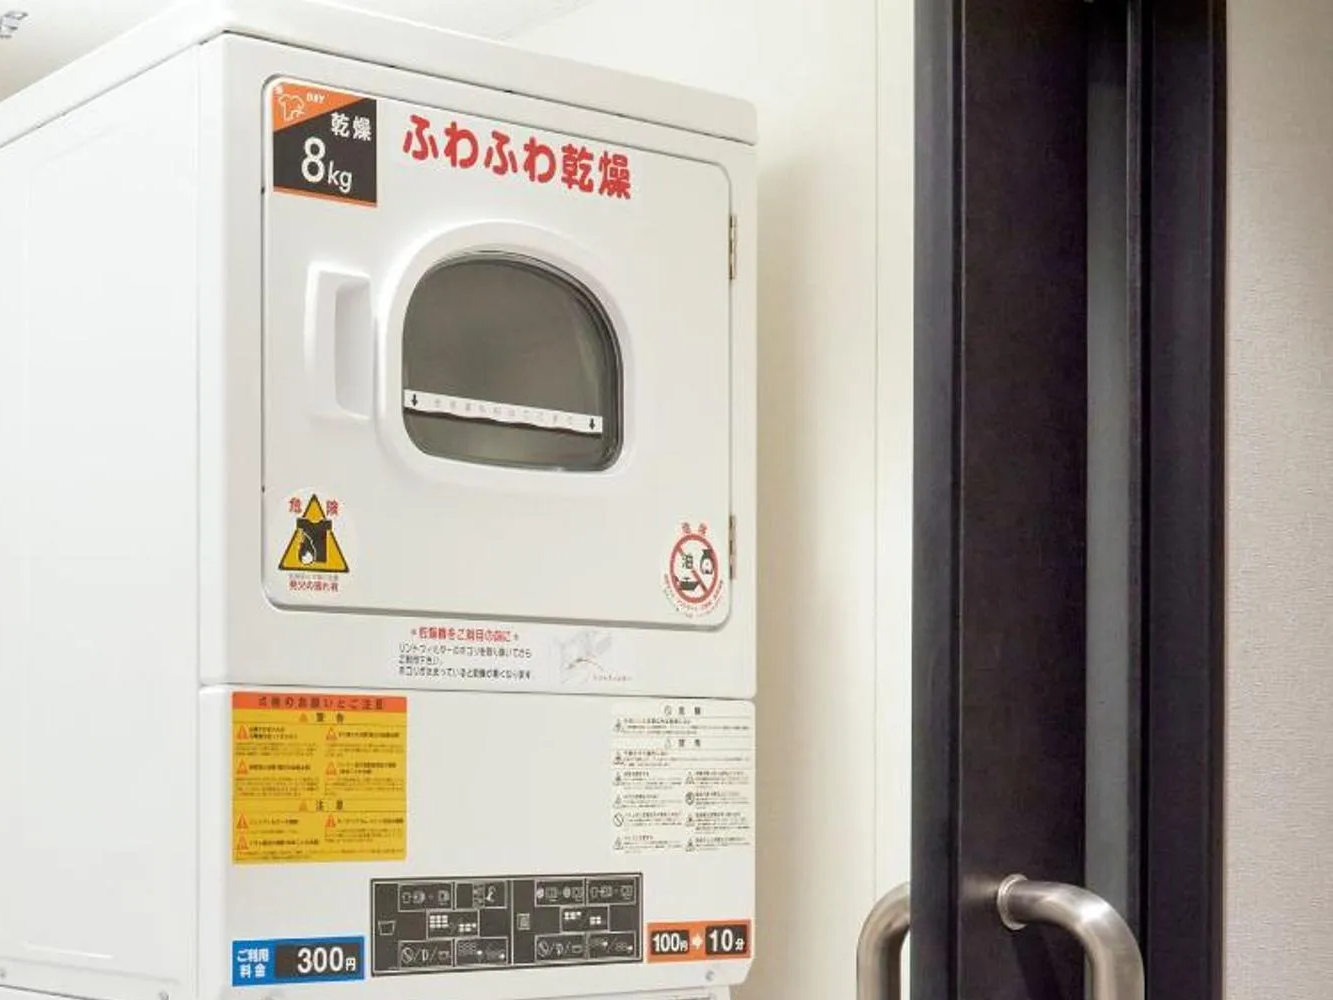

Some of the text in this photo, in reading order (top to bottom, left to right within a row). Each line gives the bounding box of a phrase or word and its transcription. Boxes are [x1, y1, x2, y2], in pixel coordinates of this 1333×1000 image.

[330, 111, 372, 142] 乾燥
[301, 136, 353, 193] 8kg
[402, 114, 631, 200] ふわふわ乾燥
[652, 932, 688, 952] 100円
[708, 928, 745, 952] 10分
[297, 946, 356, 973] 300円
